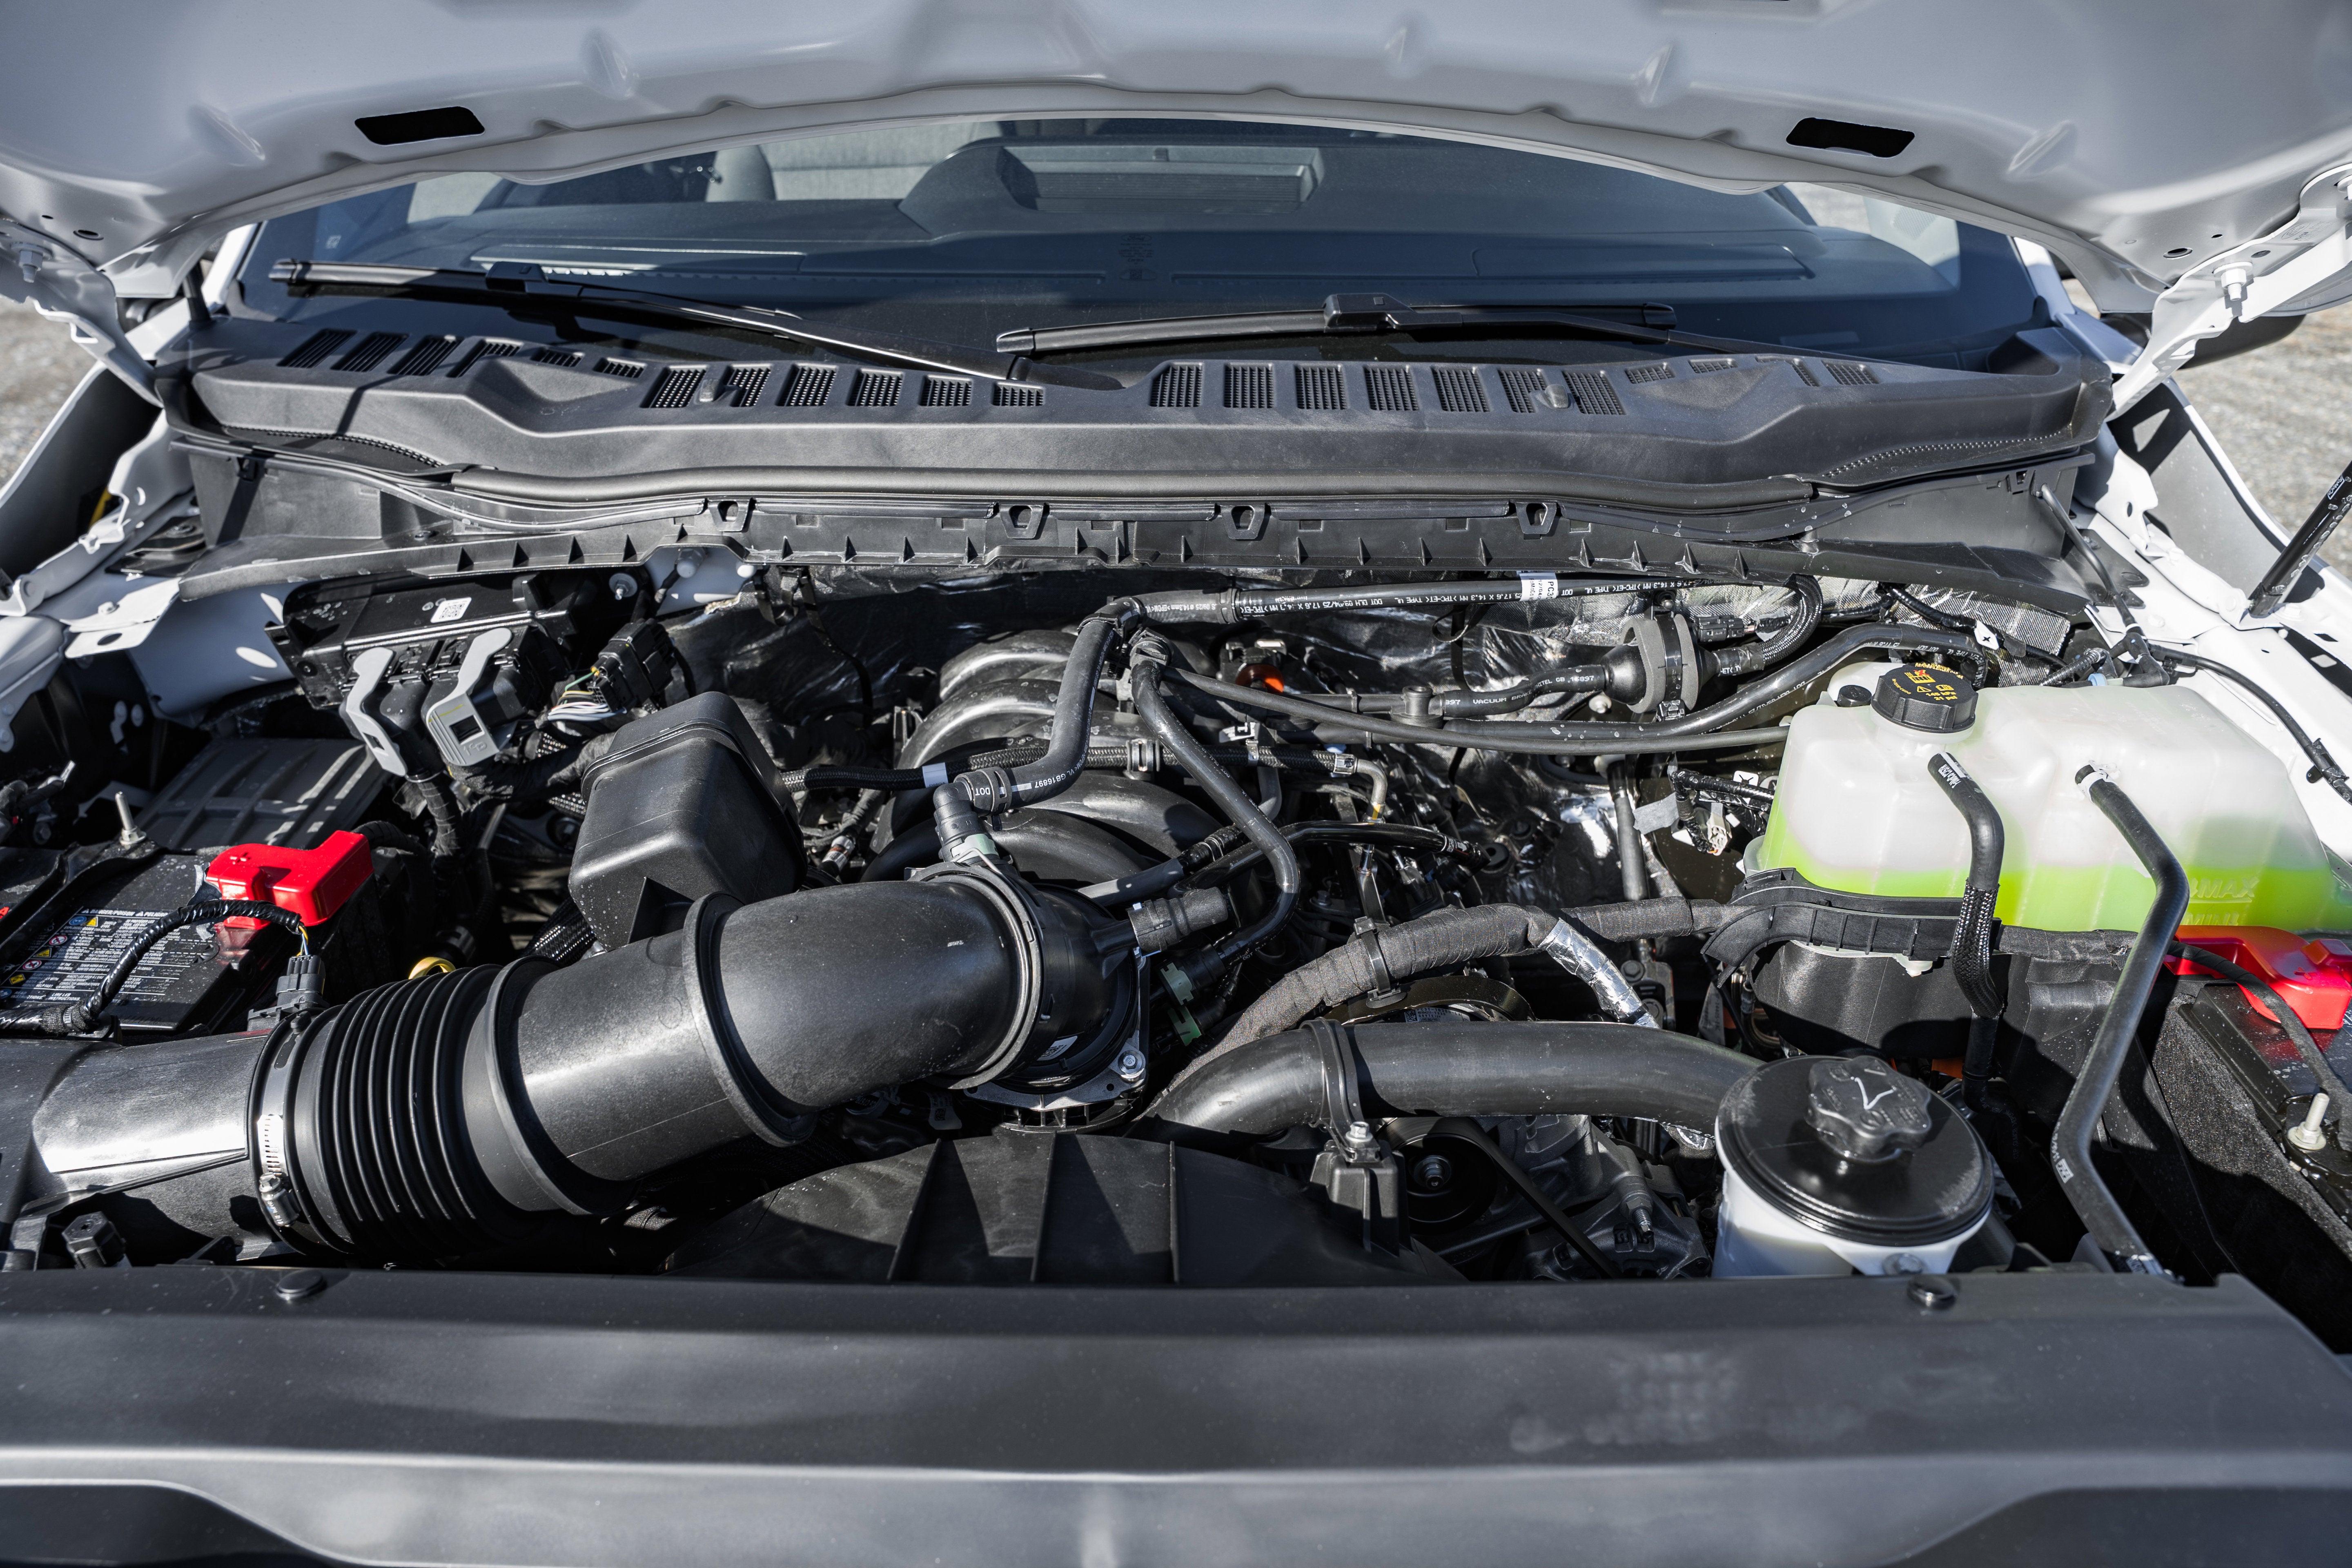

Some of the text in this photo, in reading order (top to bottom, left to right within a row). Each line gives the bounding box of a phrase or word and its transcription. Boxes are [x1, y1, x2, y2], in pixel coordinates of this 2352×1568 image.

[1511, 690, 1532, 700] BRAKE
[1221, 767, 1230, 778] DOT
[1035, 773, 1066, 788] GB16897
[975, 787, 990, 796] DOT
[2197, 877, 2260, 898] MAX
[2181, 912, 2231, 926] MIN
[1243, 952, 1253, 960] DOT
